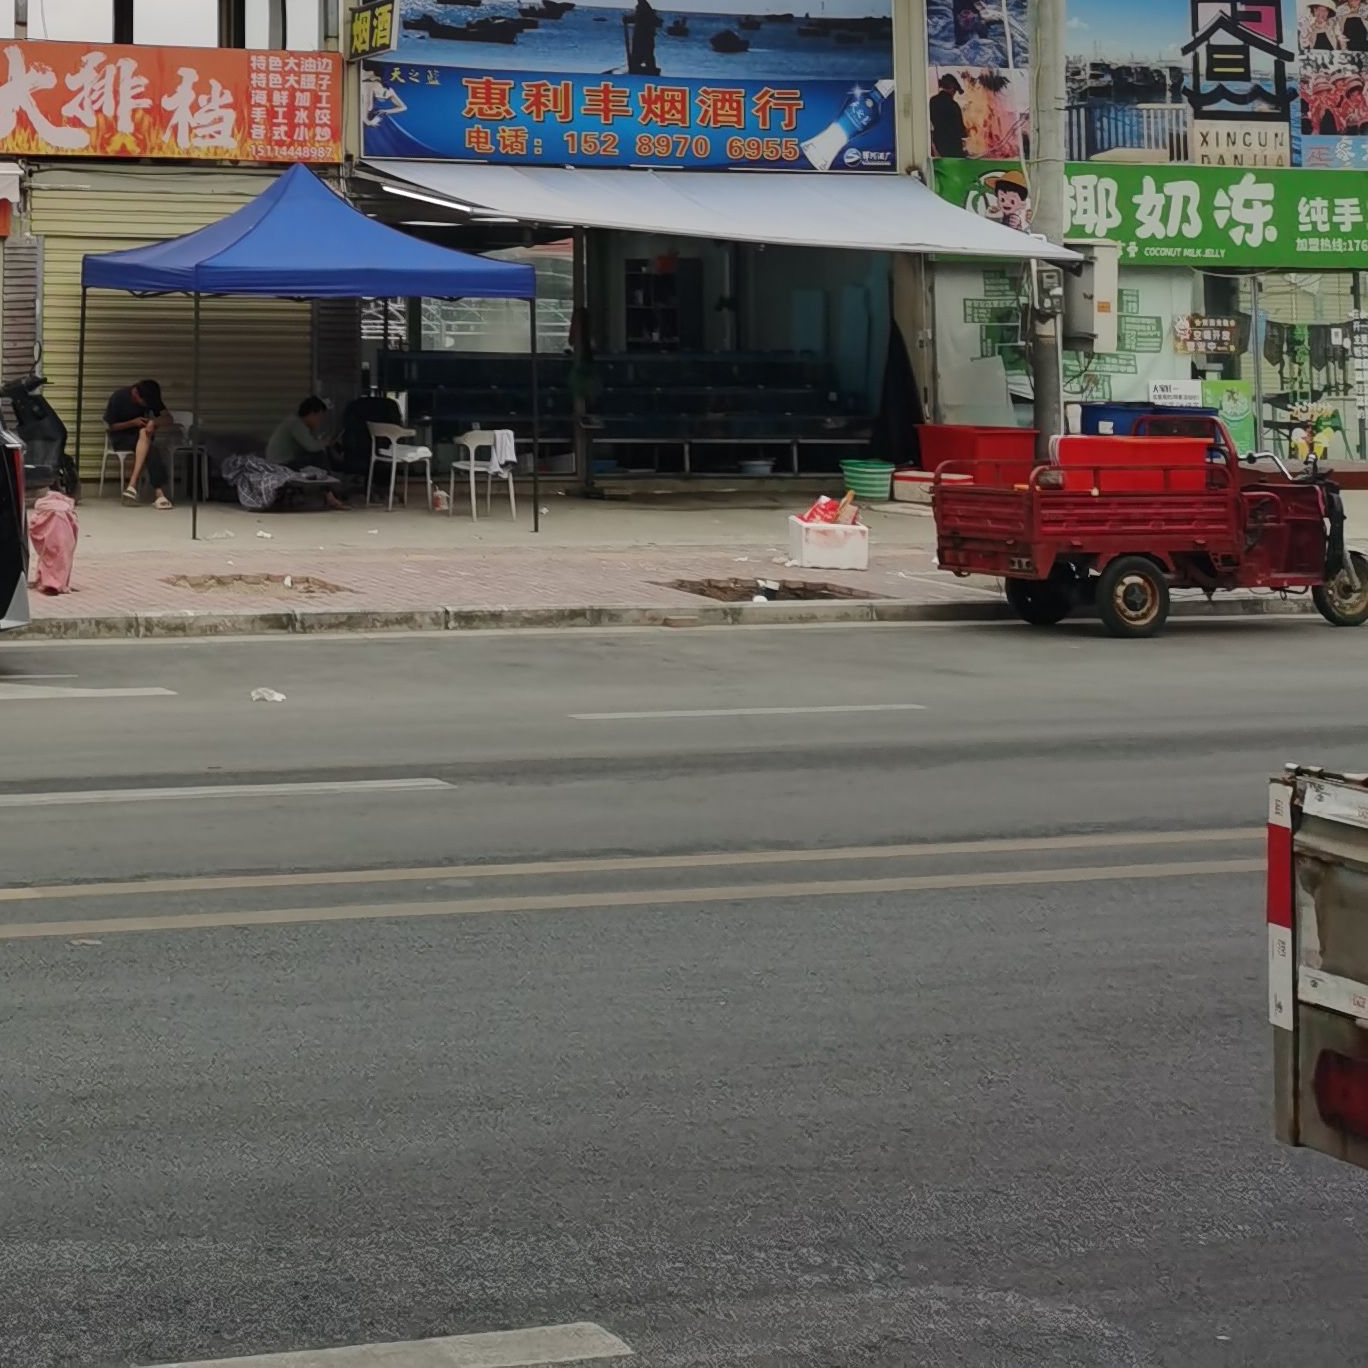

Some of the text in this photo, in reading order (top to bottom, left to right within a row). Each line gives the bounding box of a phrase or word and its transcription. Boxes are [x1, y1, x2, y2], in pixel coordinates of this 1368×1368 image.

[352, 3, 393, 53] 烟酒
[462, 77, 804, 131] 惠利丰烟酒行
[564, 131, 620, 157] 152
[636, 133, 711, 159] 8970
[726, 136, 800, 162] 6955
[1297, 196, 1368, 232] 纯手
[1144, 247, 1182, 258] COCONUT
